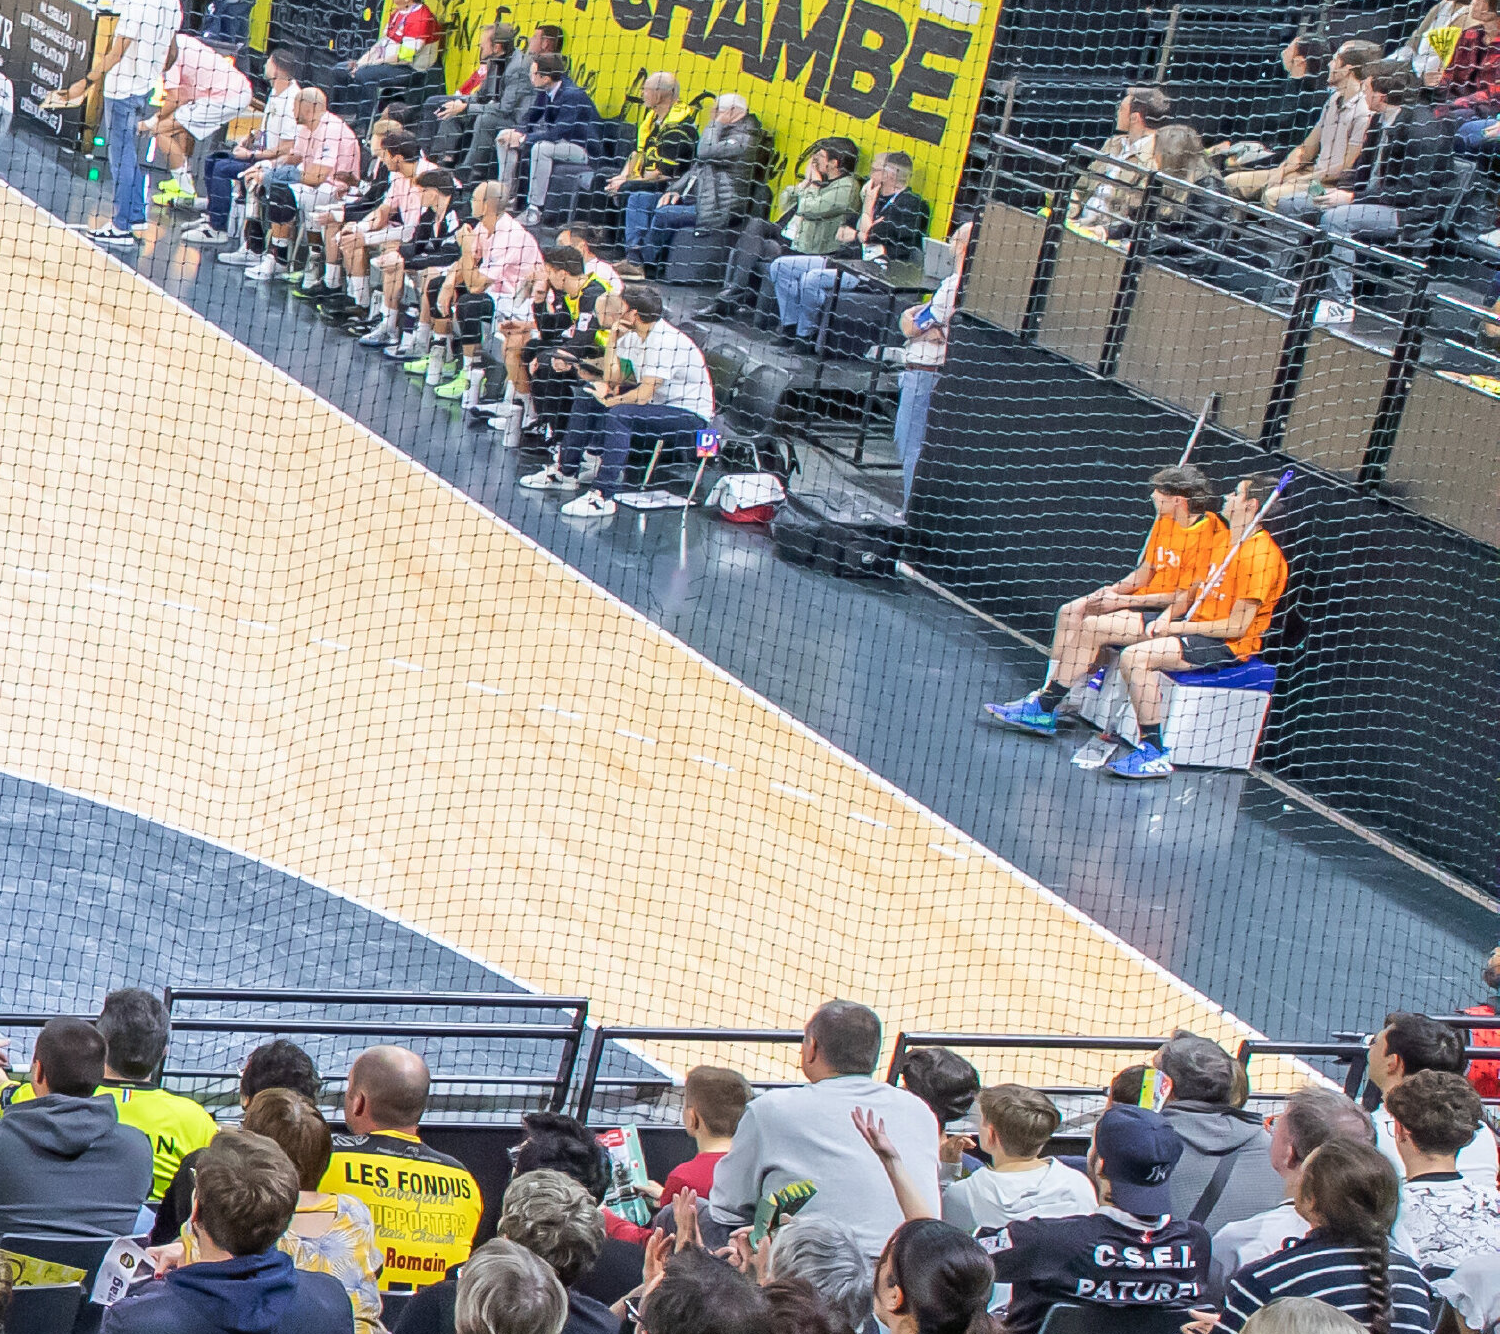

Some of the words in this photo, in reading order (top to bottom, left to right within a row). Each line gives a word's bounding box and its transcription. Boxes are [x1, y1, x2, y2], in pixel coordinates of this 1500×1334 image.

[344, 1162, 389, 1187] LES
[399, 1171, 471, 1199] FONDUS
[372, 1207, 467, 1237] UPPORTERS
[384, 1247, 446, 1273] Romain
[1093, 1244, 1197, 1269] C.S.E.I.
